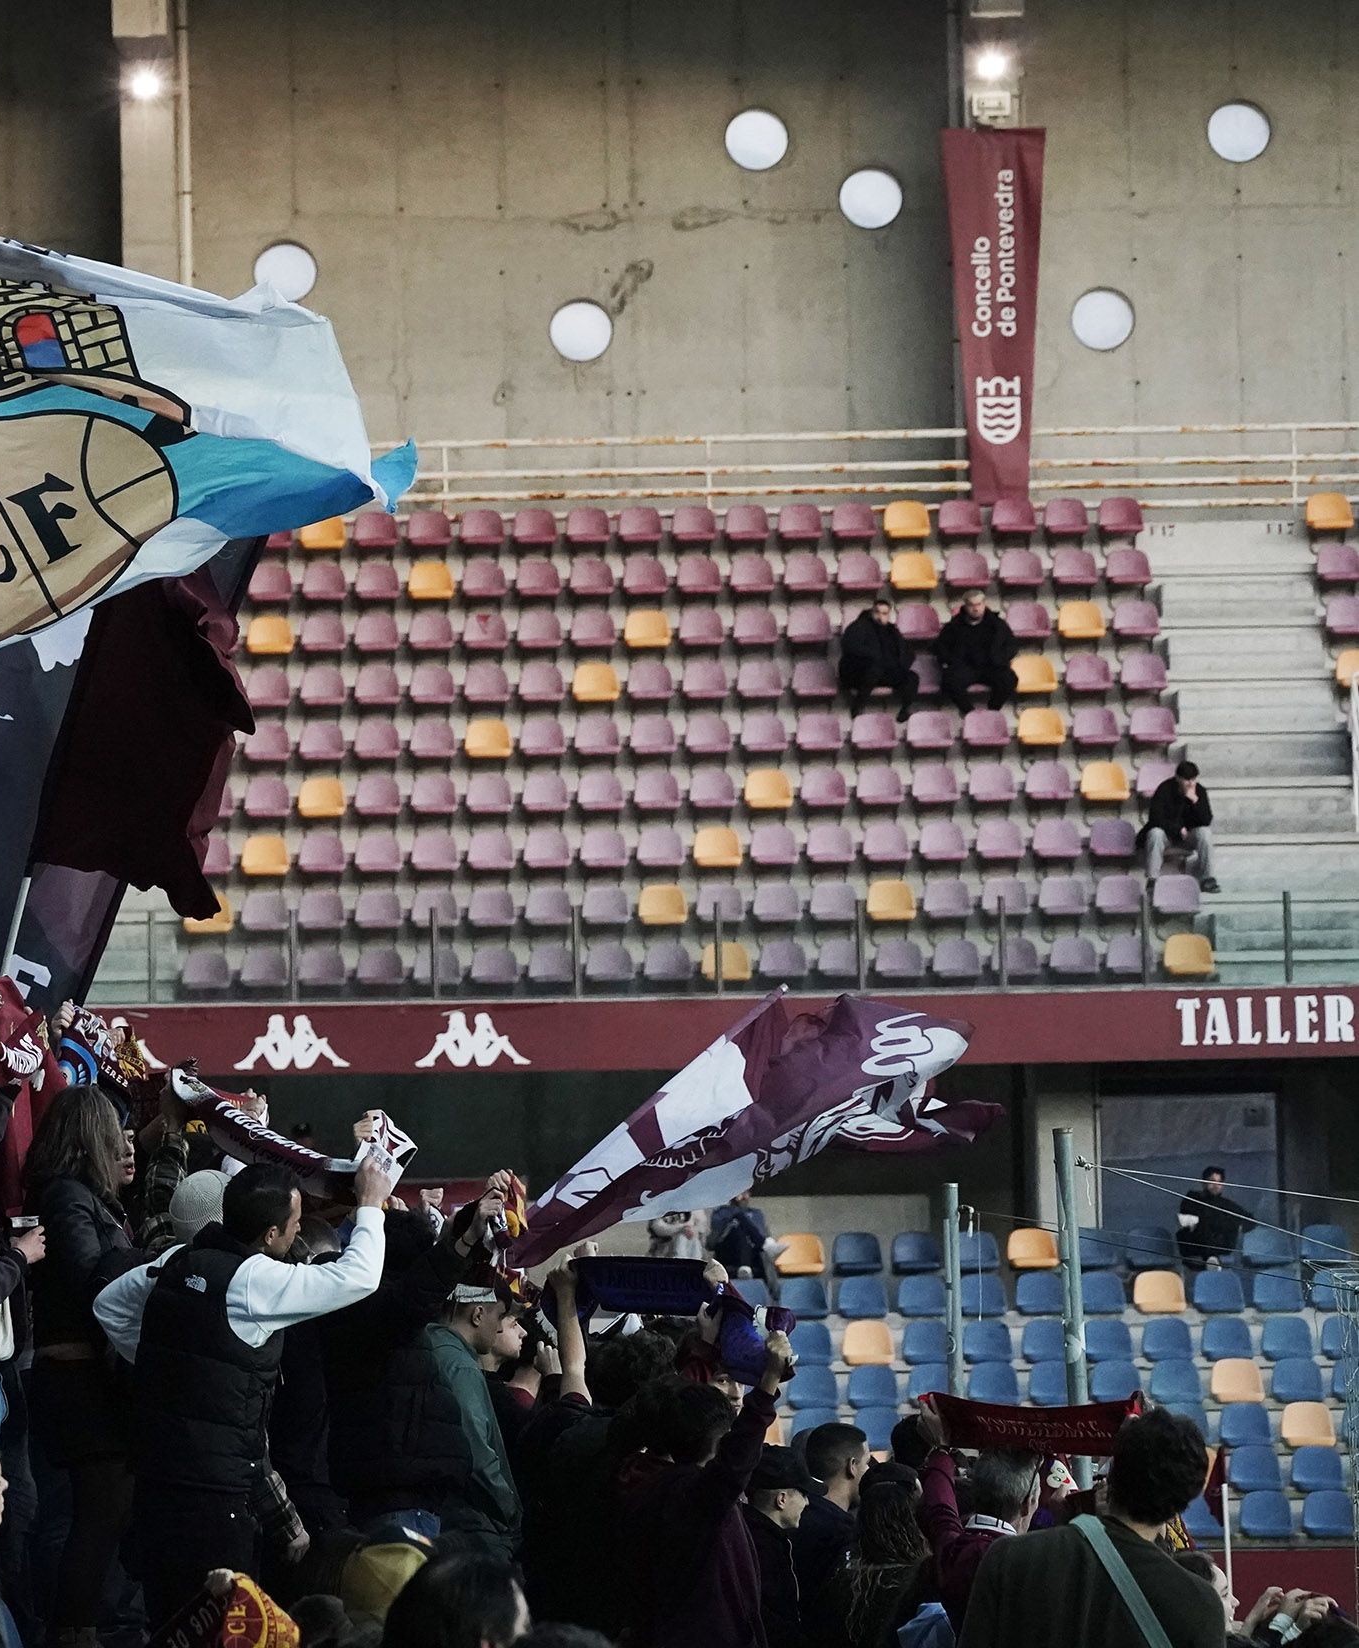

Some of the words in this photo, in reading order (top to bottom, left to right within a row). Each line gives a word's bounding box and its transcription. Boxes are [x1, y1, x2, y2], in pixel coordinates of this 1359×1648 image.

[994, 168, 1016, 302] Pontevedra
[971, 236, 992, 338] Concello
[996, 306, 1017, 338] de
[1175, 994, 1356, 1047] TALLER
